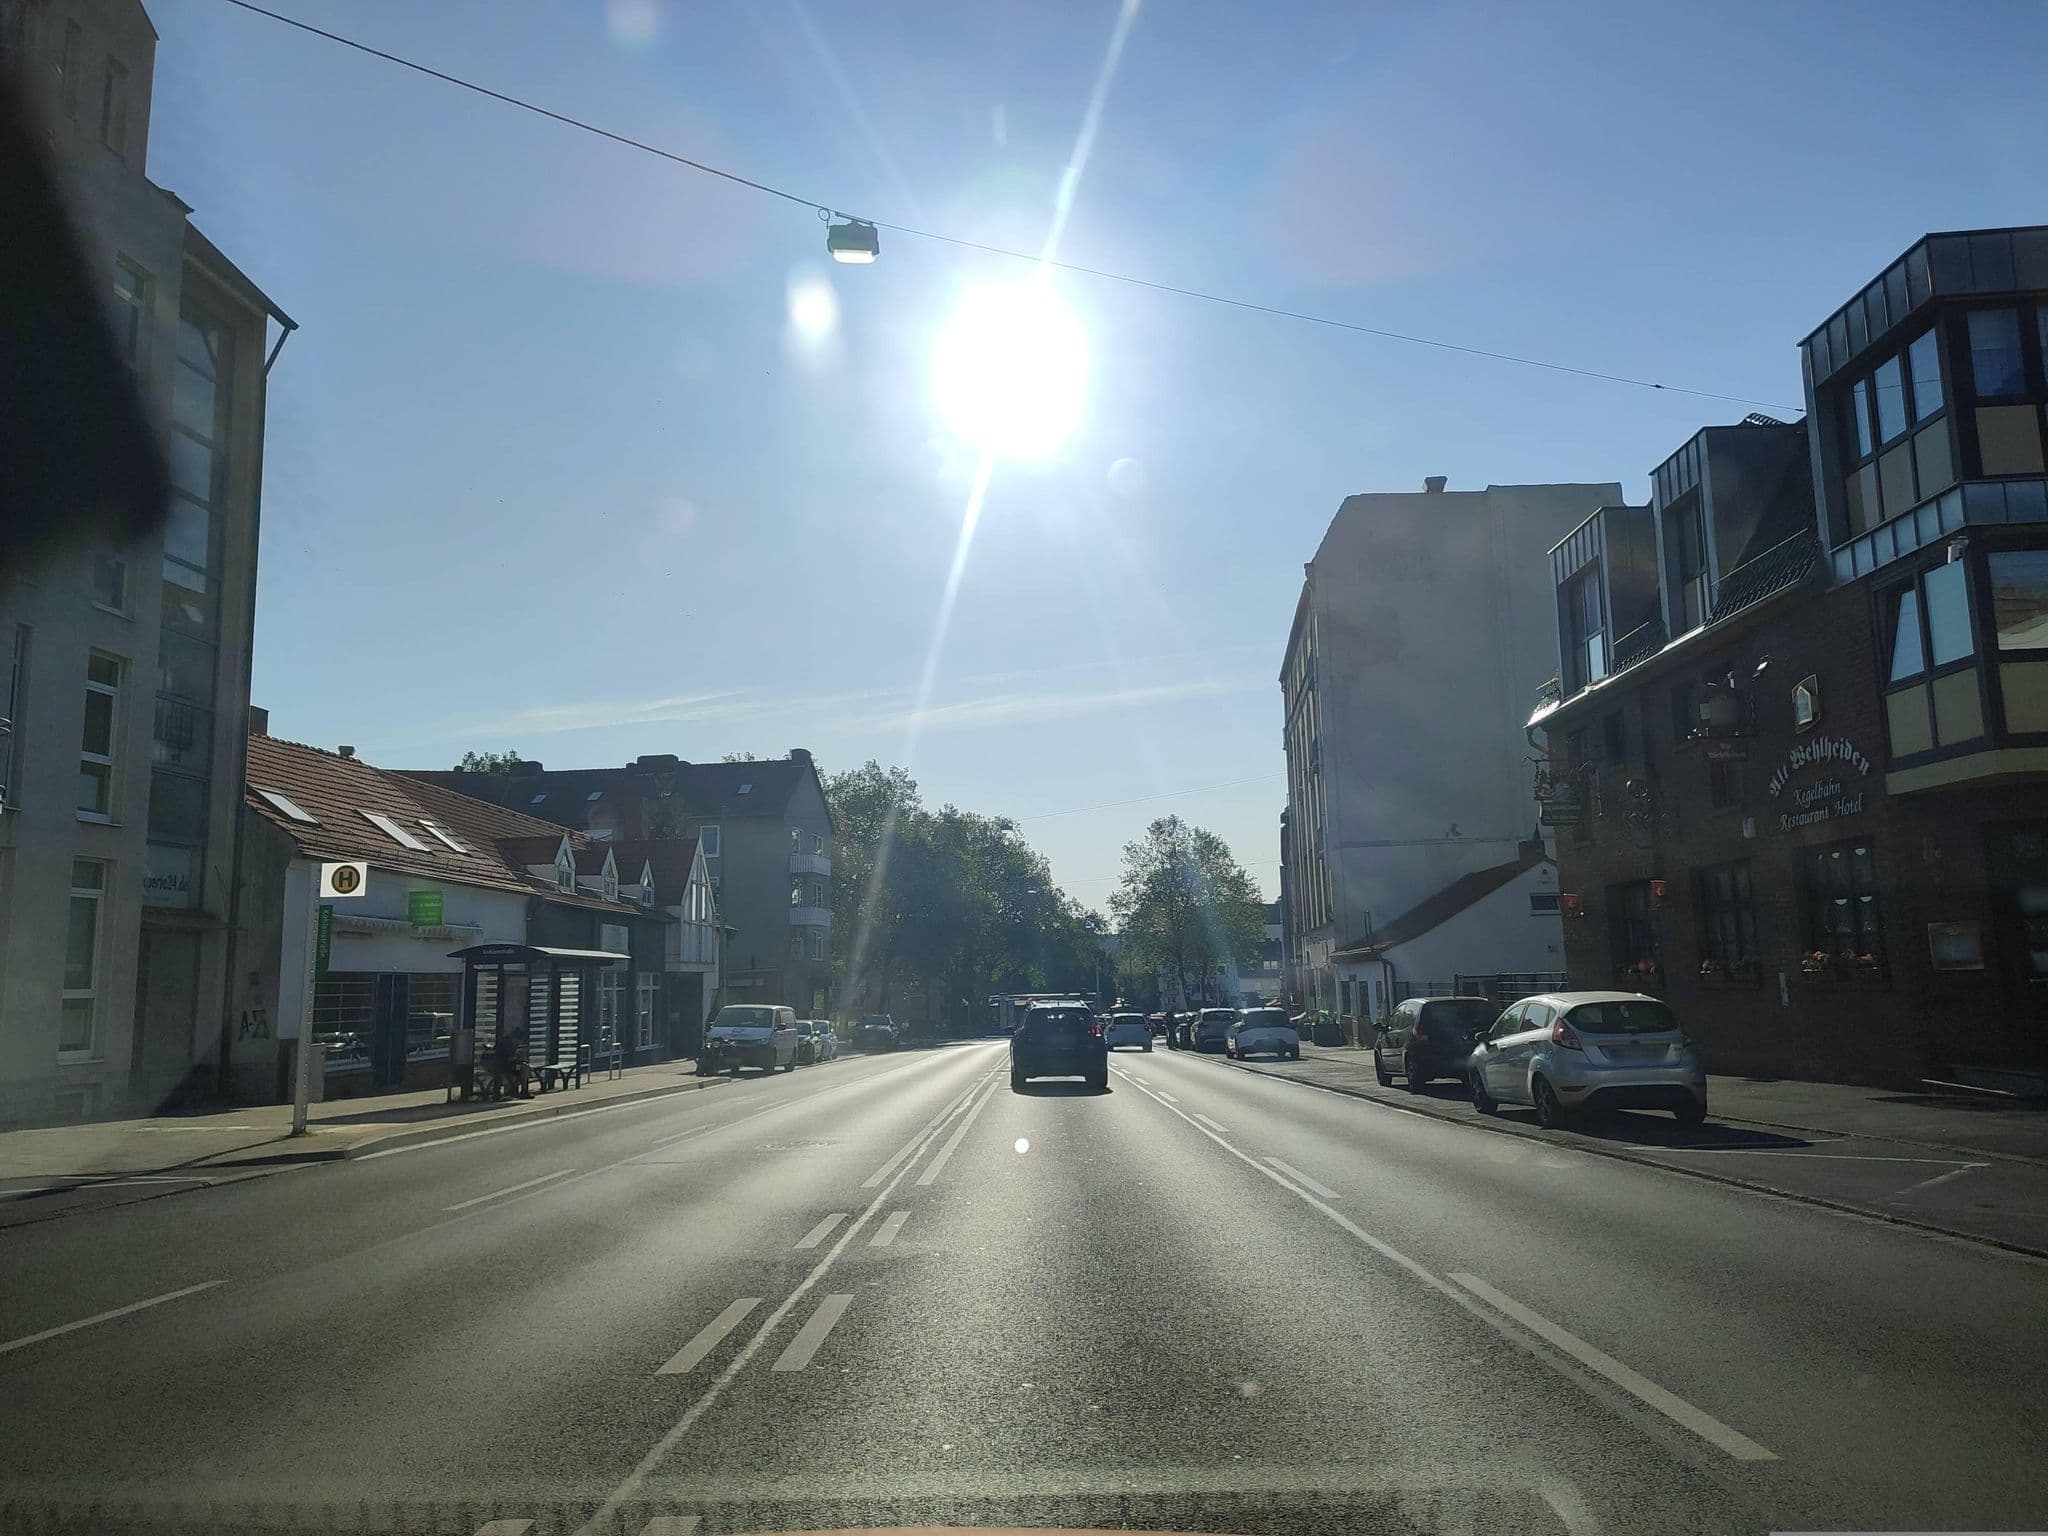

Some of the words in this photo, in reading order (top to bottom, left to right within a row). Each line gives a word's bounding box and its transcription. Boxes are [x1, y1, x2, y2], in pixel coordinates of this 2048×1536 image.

[1769, 763, 1790, 798] Alt
[1789, 735, 1871, 777] Wehlheiden
[1793, 778, 1841, 809] Kegelbahn
[1778, 806, 1829, 833] Restaurant
[1833, 791, 1864, 817] Hotel
[338, 872, 353, 887] H
